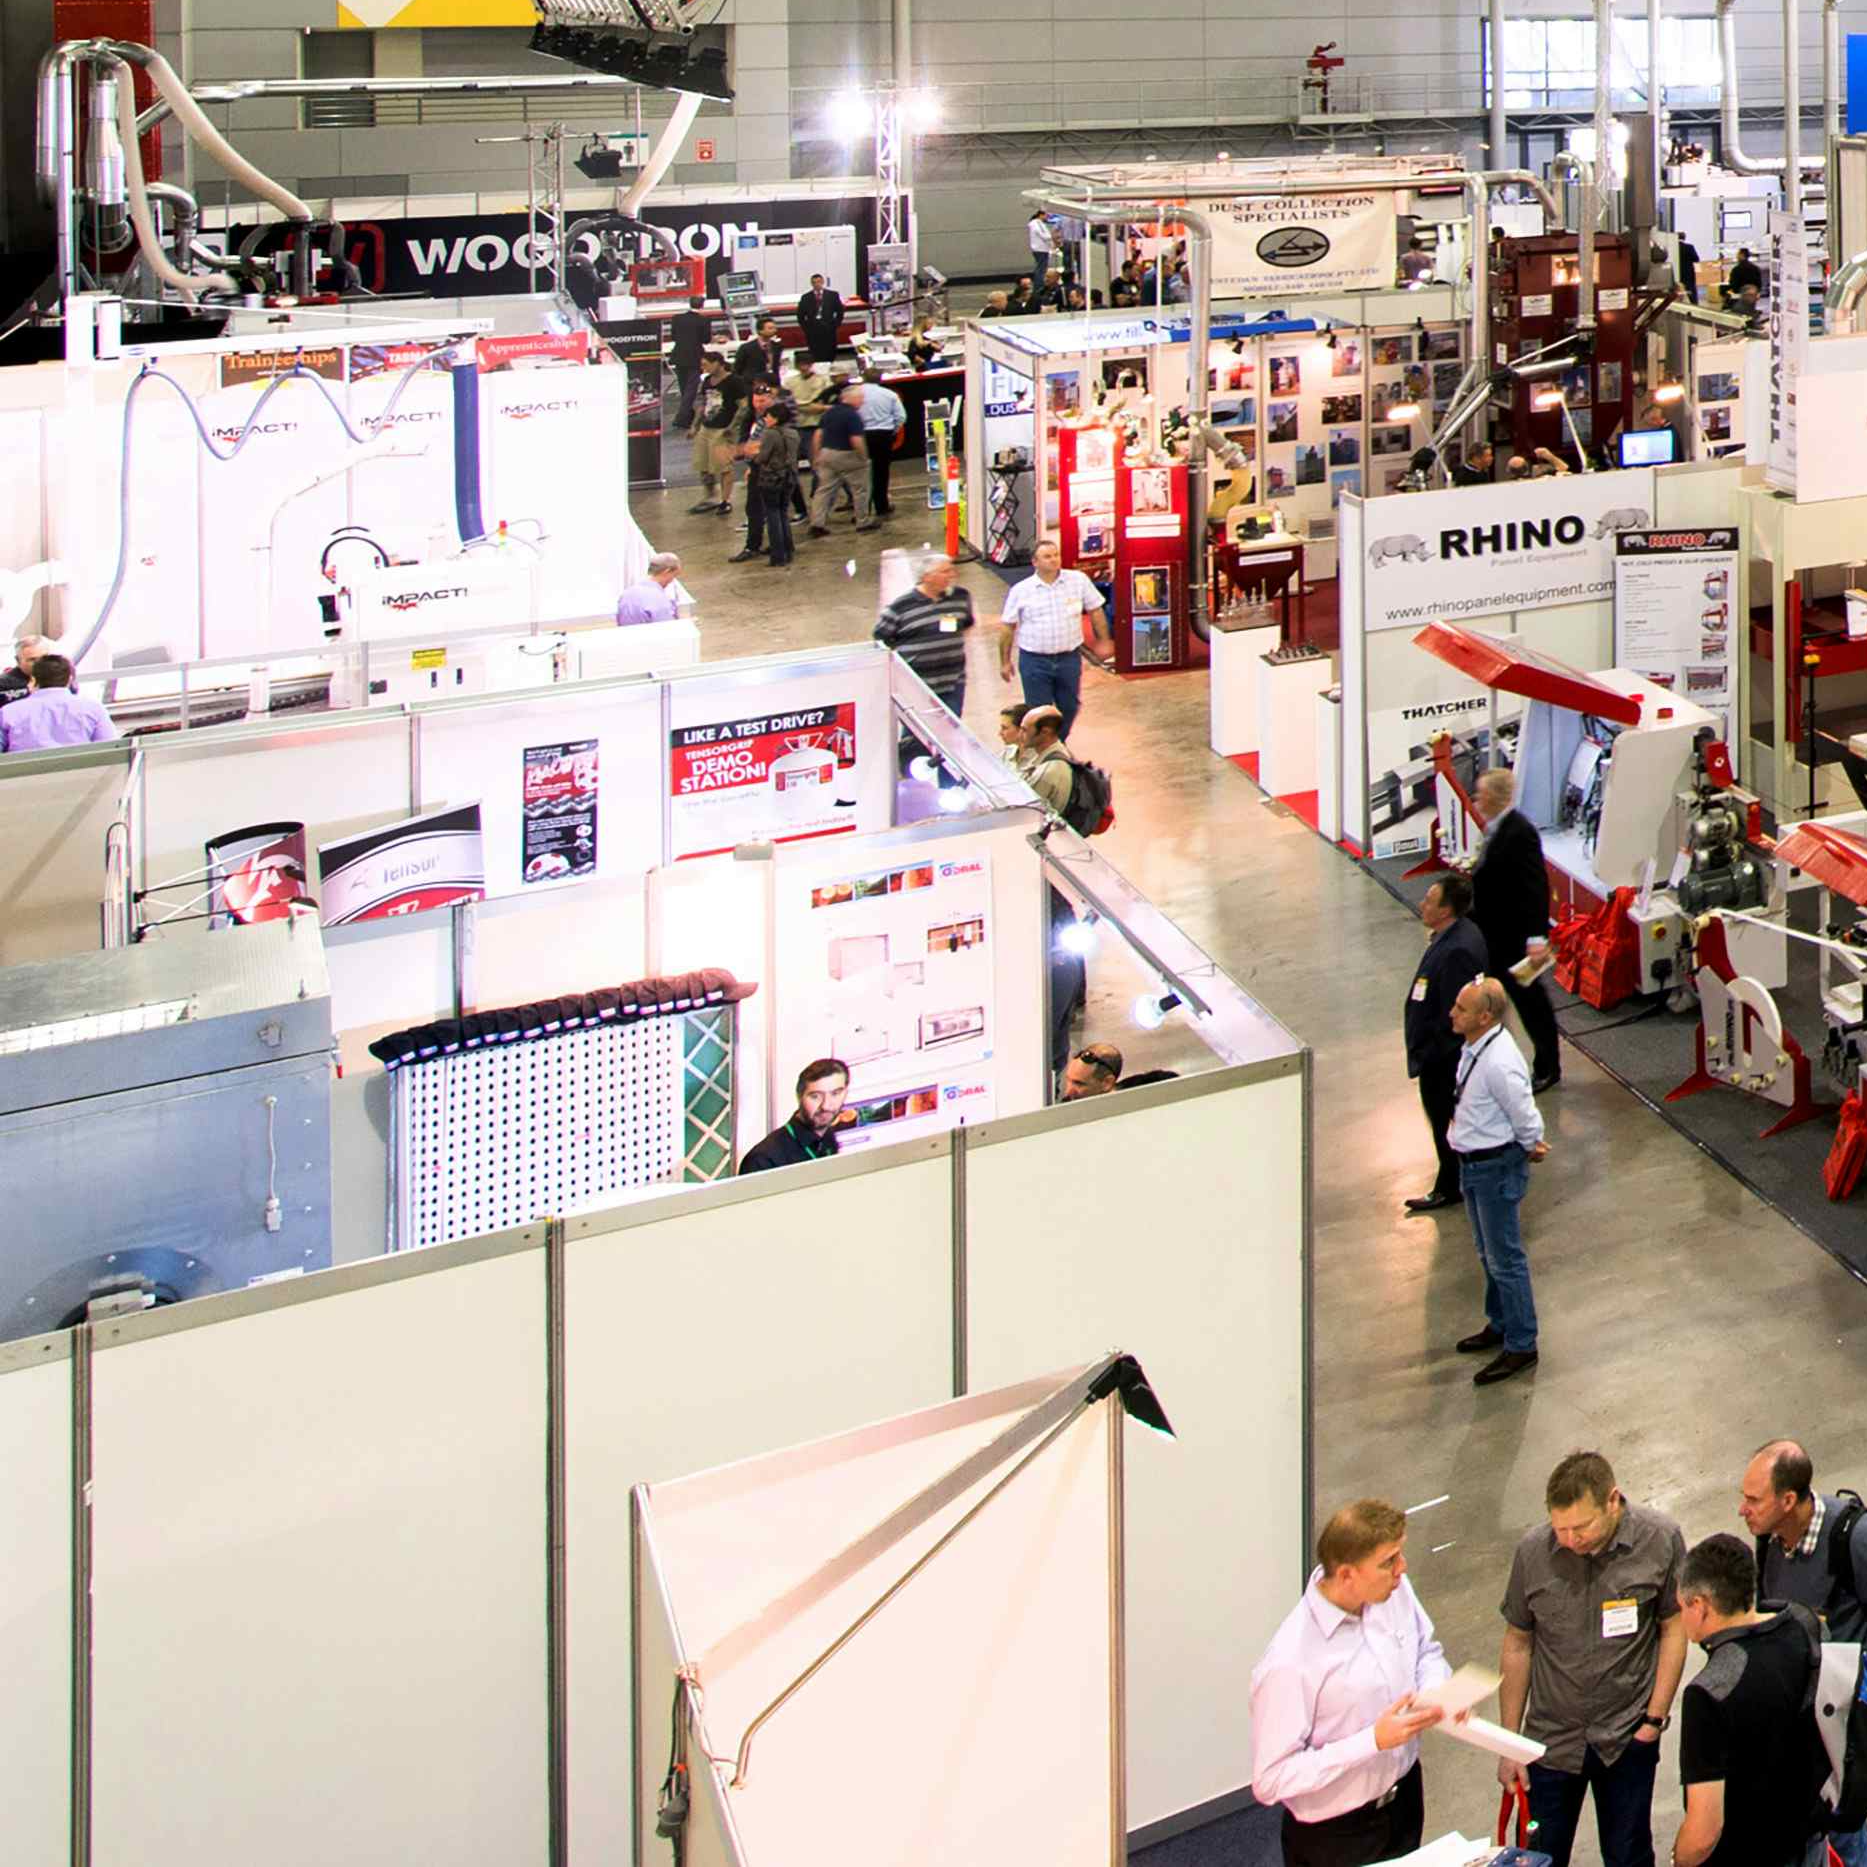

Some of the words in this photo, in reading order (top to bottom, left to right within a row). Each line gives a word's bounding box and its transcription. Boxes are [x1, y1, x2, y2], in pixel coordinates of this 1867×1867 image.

[1208, 202, 1252, 213] DUST
[1263, 195, 1375, 211] COLLECTION
[1233, 208, 1351, 224] SPECIALISTS
[408, 221, 759, 276] WOODRON
[487, 336, 580, 358] Apprenticeships
[227, 348, 338, 369] Traineehips
[987, 404, 1017, 418] .DUS
[1440, 514, 1585, 560] RHINO
[1648, 533, 1706, 548] RHINO
[1527, 547, 1588, 564] Equipment
[382, 587, 469, 606] iMPACT!
[1402, 697, 1488, 721] THATCHER
[684, 729, 716, 745] LIKE
[719, 726, 732, 740] A
[735, 721, 768, 738] TEST
[771, 711, 825, 732] DRIVE?
[685, 738, 755, 761] TENSORGRIP
[691, 750, 753, 777] DEMO
[680, 761, 767, 794] STATION!
